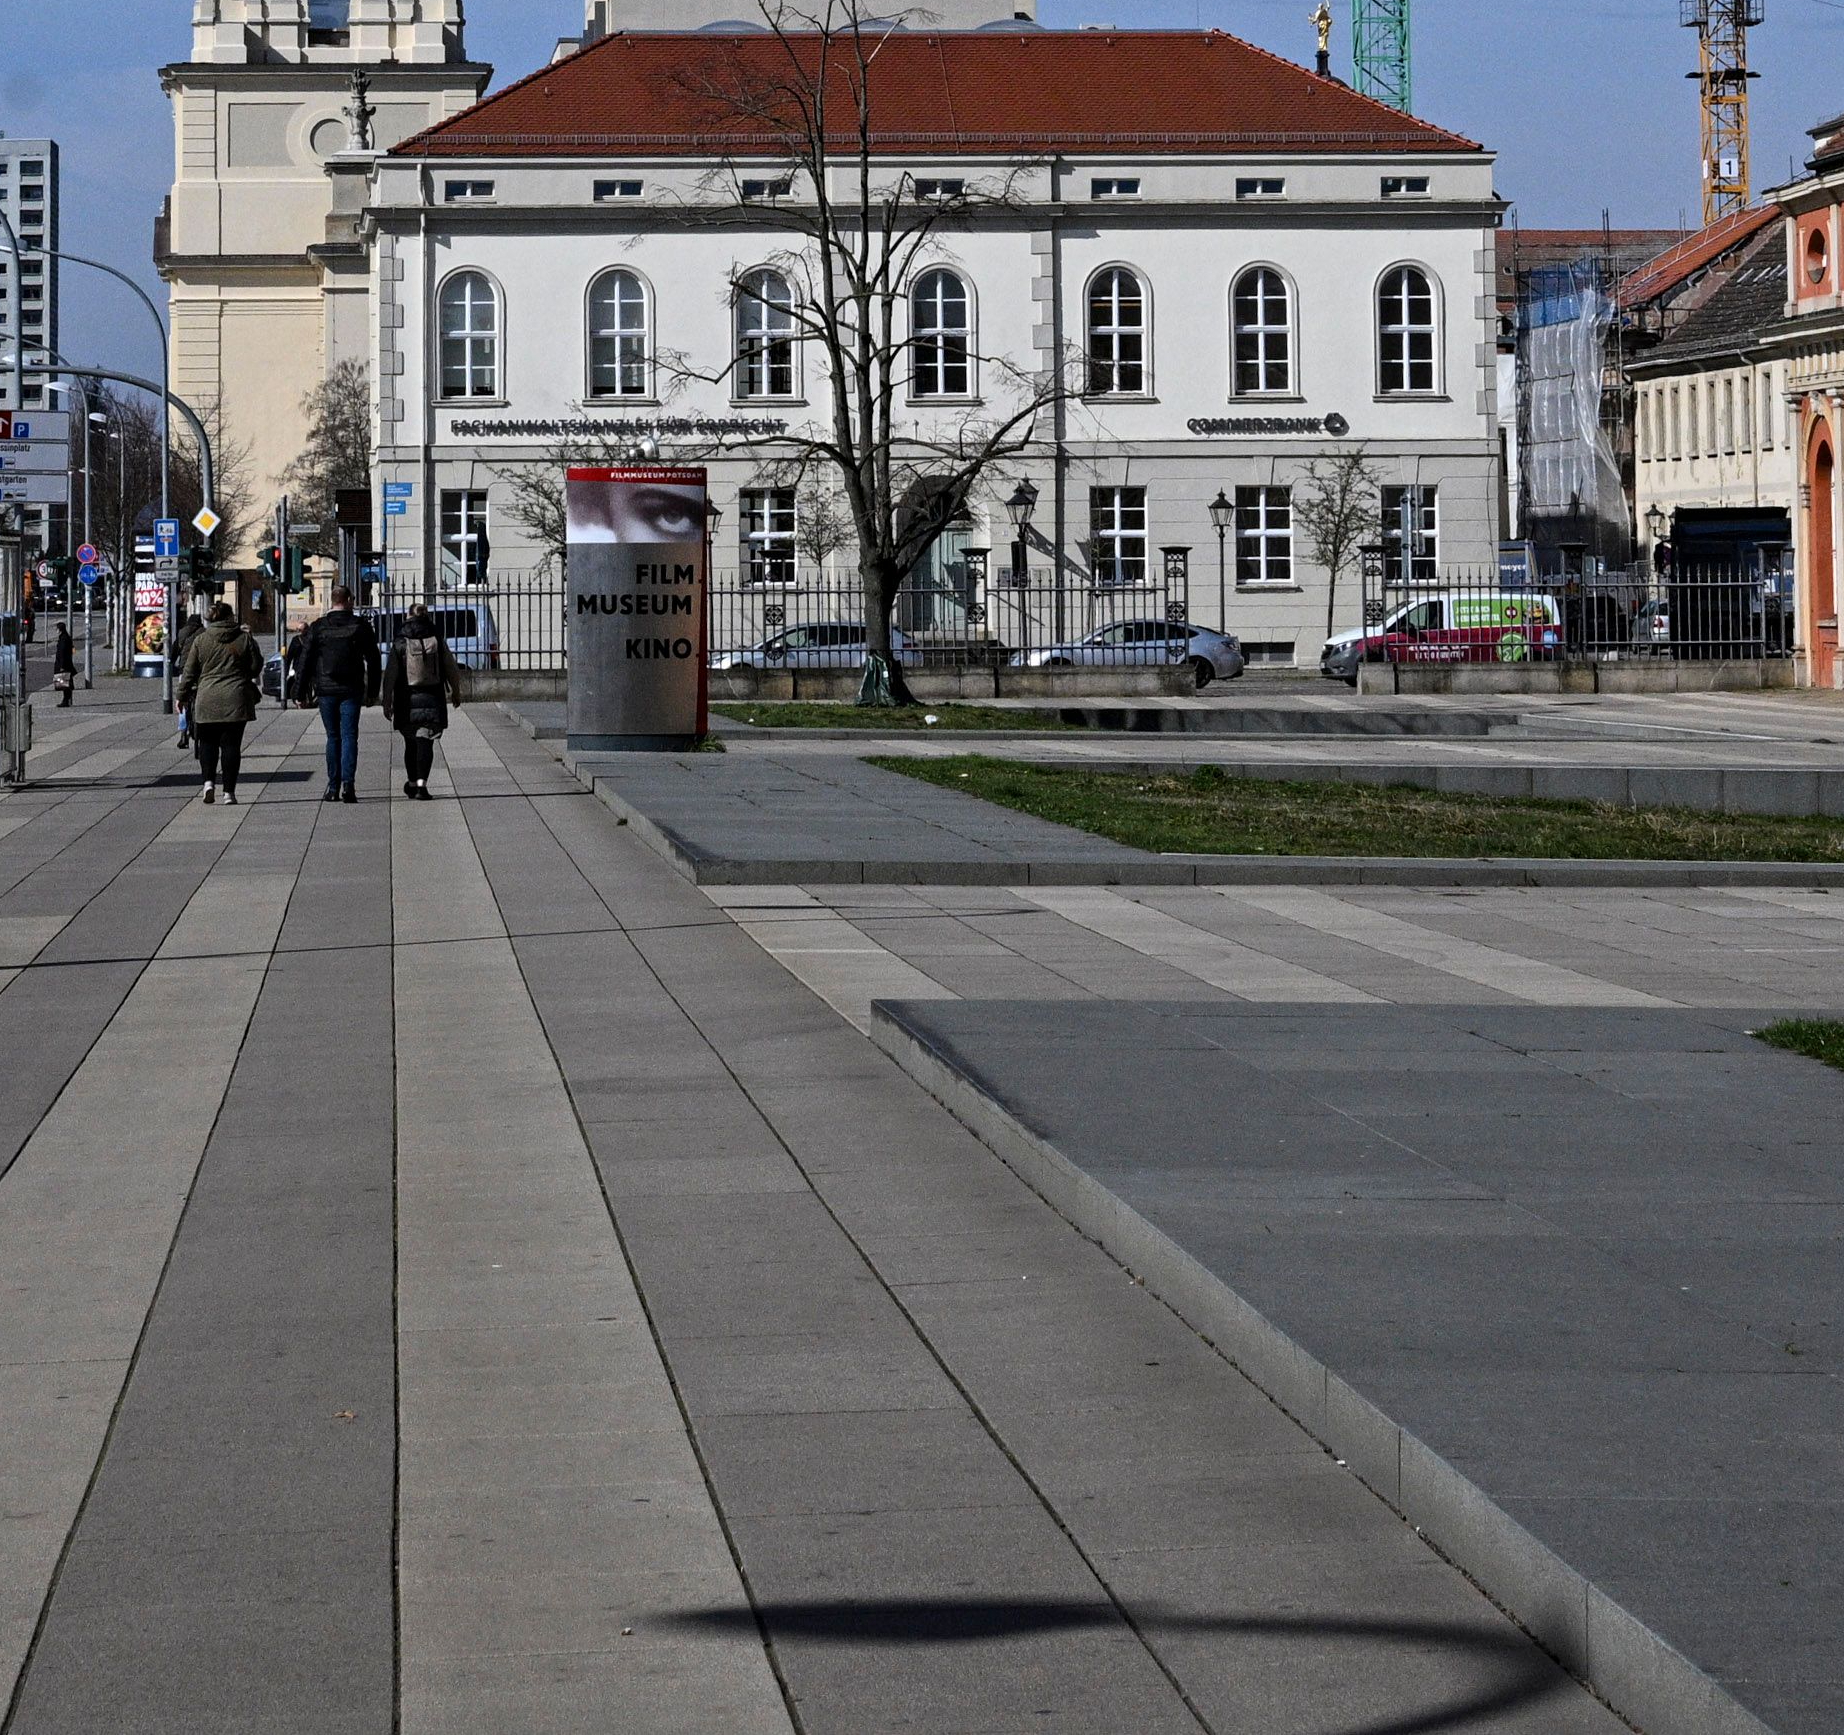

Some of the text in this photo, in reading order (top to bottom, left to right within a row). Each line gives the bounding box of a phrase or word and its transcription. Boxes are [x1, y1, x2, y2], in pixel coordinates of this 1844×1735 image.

[1187, 418, 1322, 433] COMMERZBANK
[636, 564, 694, 585] FILM
[136, 591, 164, 606] 20%
[577, 594, 692, 615] MUSEUM
[625, 638, 692, 660] KINO
